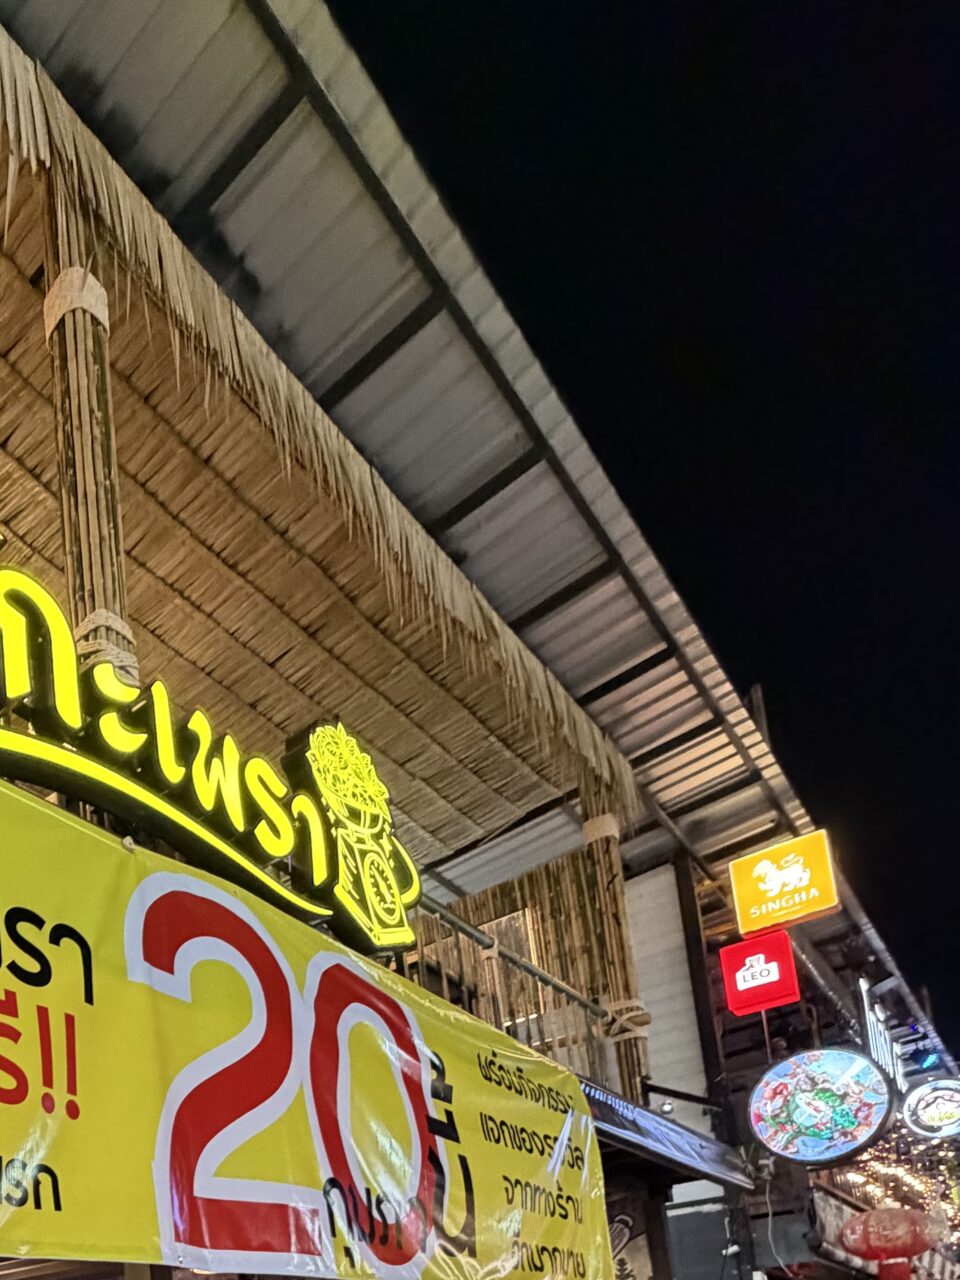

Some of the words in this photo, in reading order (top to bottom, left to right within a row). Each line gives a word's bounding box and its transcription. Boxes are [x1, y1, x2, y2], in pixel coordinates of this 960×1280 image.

[749, 887, 820, 918] SINGHA
[742, 967, 771, 983] LEO
[124, 872, 444, 1280] 20
